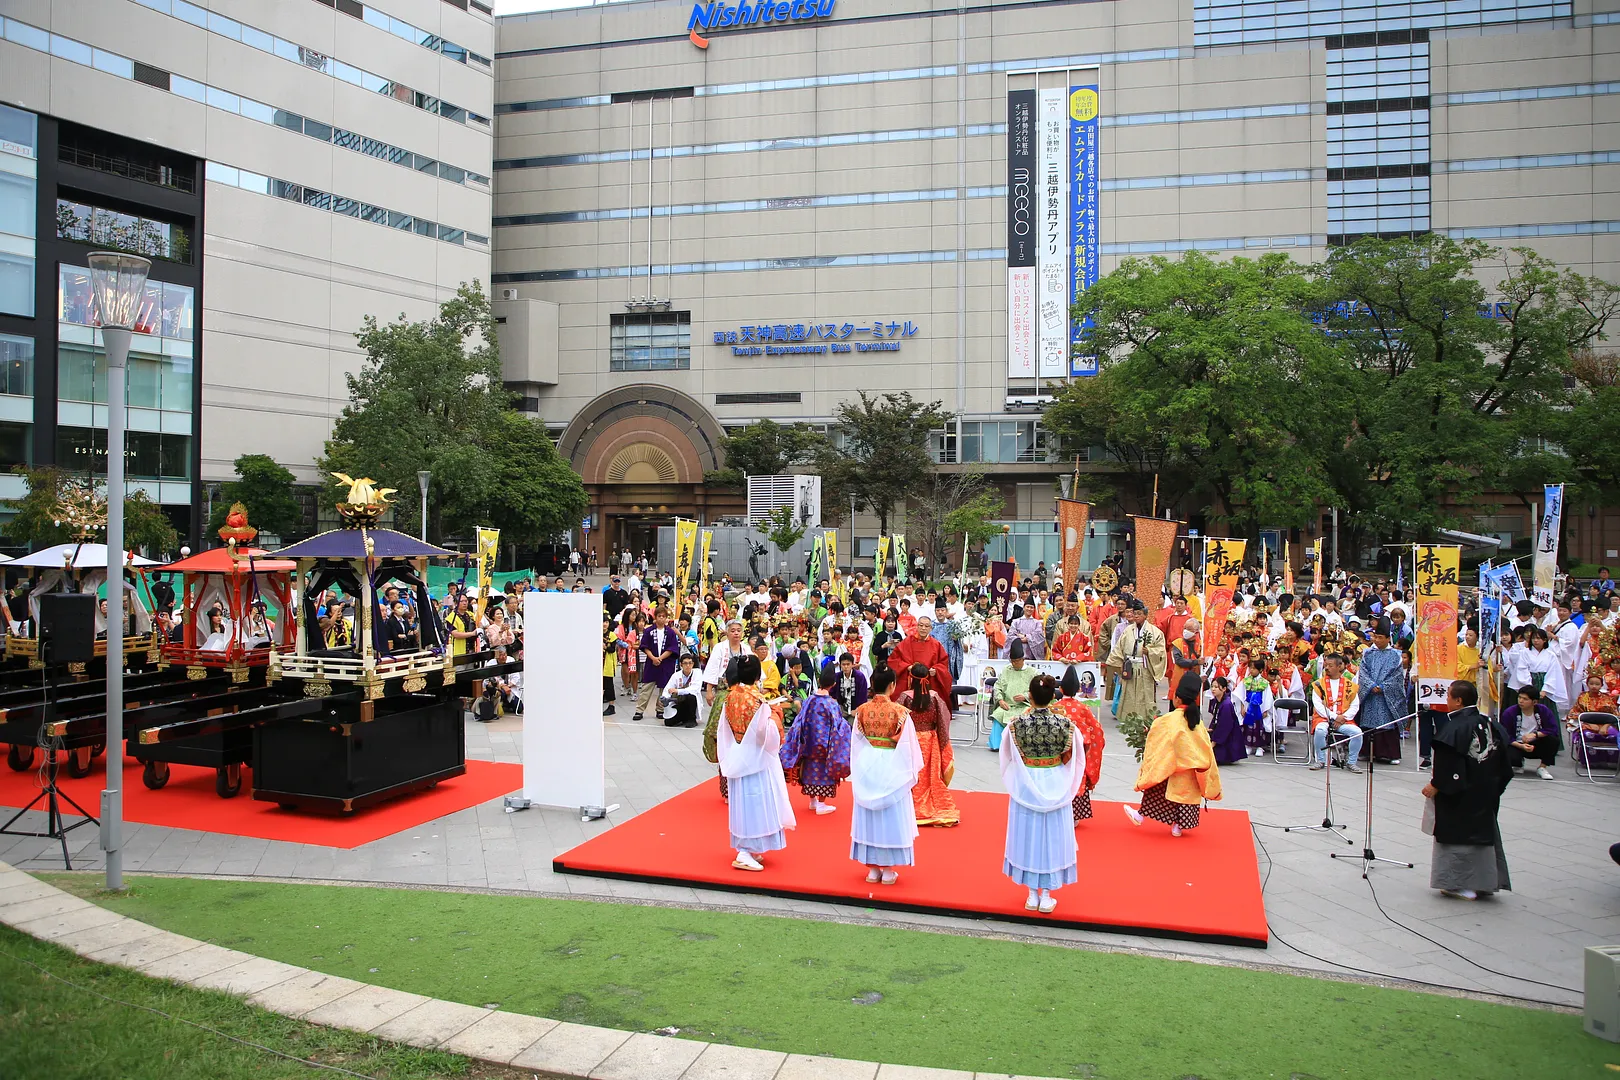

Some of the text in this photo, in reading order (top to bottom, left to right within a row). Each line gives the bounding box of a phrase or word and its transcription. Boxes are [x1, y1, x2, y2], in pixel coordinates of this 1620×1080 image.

[687, 0, 836, 30] Nishitetsu
[1075, 107, 1093, 117] 無料
[1021, 102, 1029, 156] 三越伊勢丹化粧品
[1047, 162, 1060, 255] 三越伊勢丹アプリ
[731, 341, 901, 357] Tenjin Expressway Bus Terminal
[74, 447, 137, 457] ESTNAON
